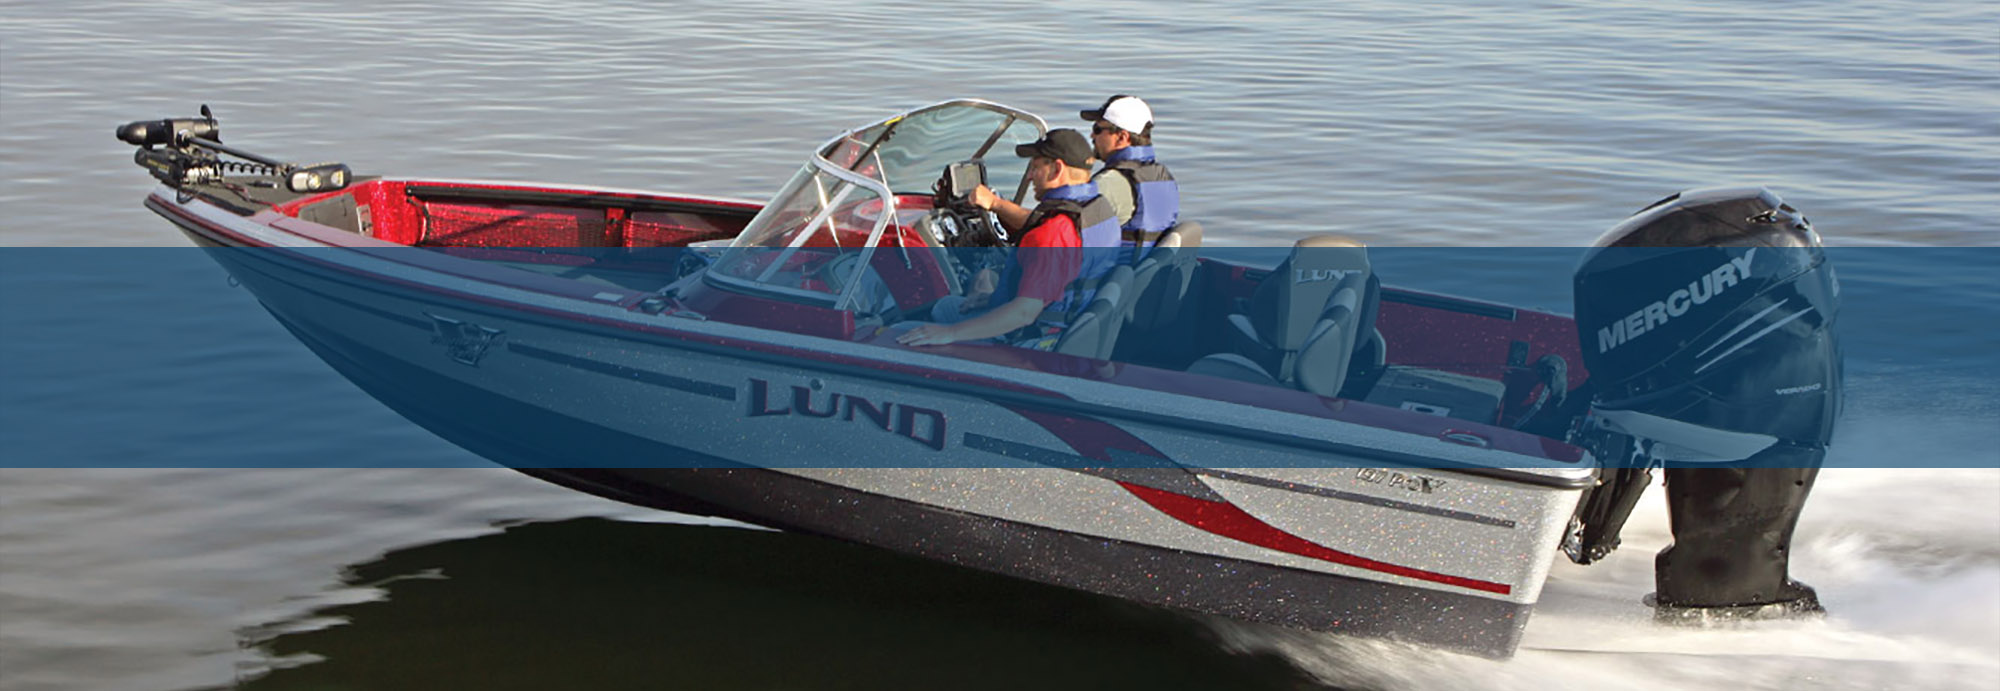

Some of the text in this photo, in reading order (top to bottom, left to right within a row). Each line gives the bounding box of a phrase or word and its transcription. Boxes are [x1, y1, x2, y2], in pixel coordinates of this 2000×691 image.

[1296, 269, 1362, 284] LUN
[1597, 247, 1757, 355] MERCURY
[748, 377, 946, 452] LUND
